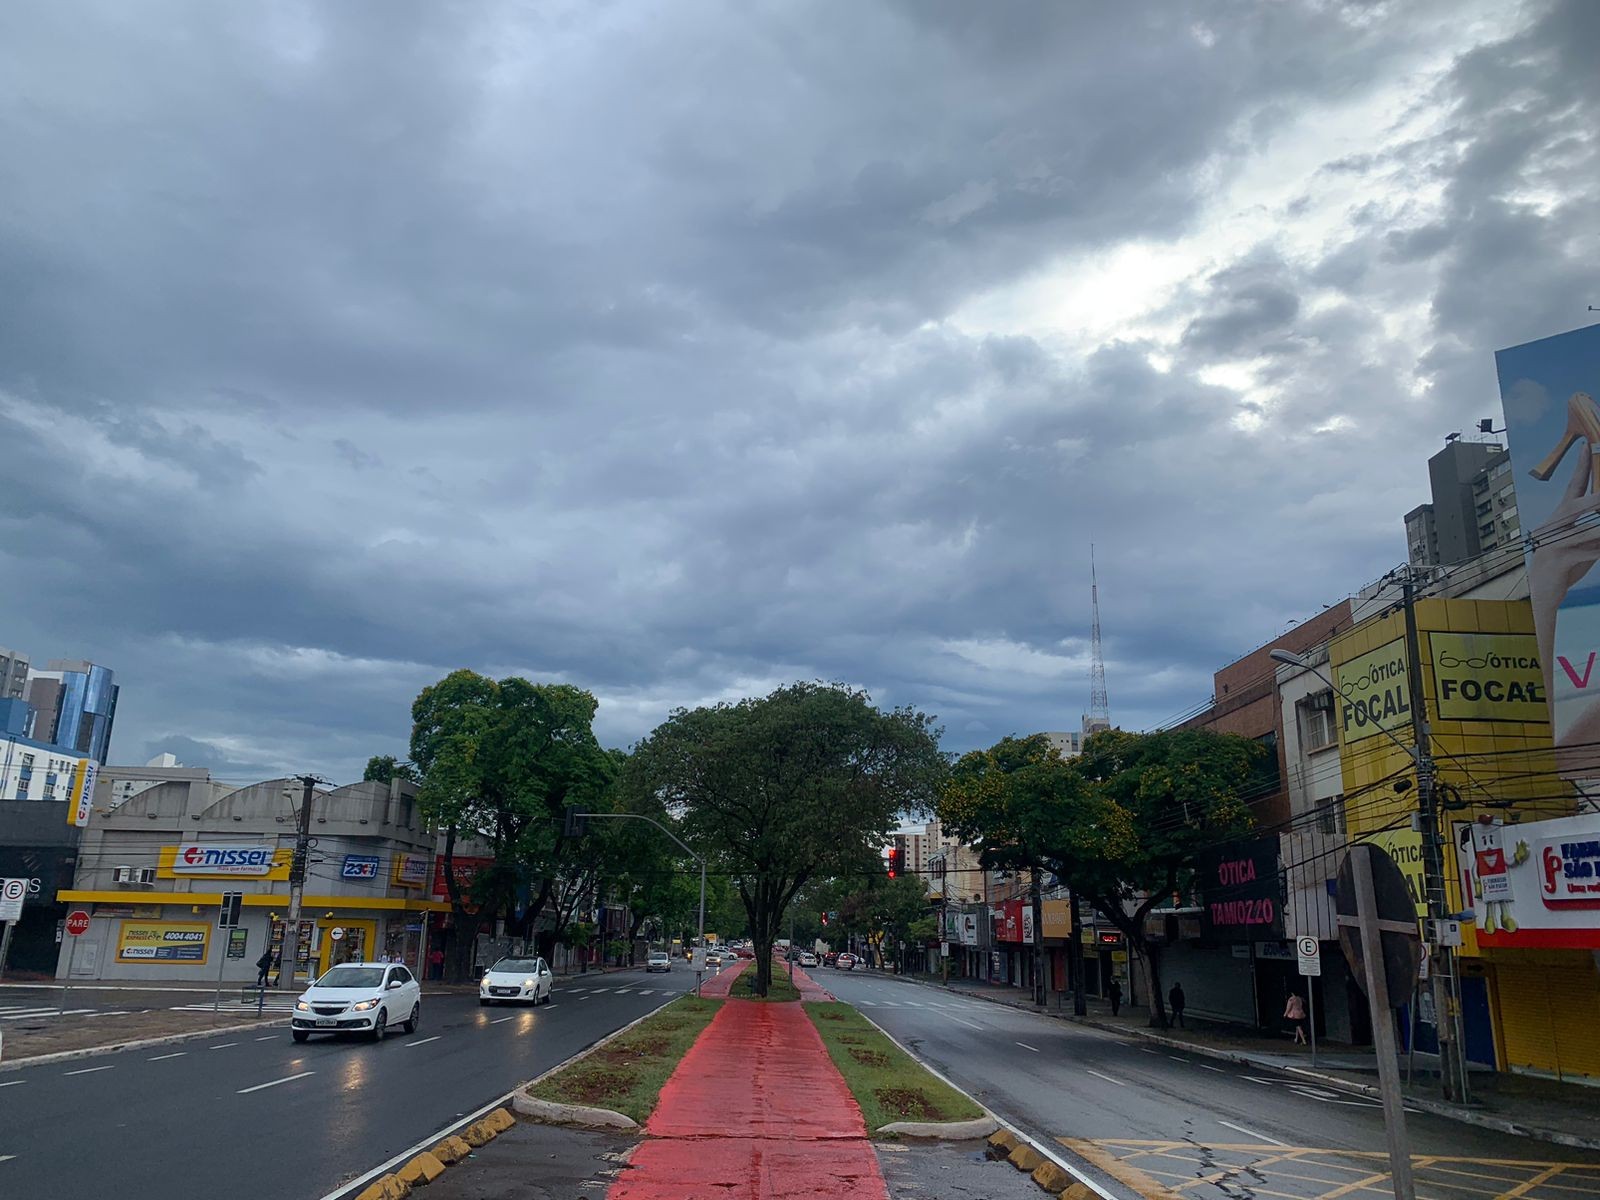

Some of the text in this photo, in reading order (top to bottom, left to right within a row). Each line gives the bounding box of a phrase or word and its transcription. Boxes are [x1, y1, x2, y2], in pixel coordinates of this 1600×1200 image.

[1490, 653, 1541, 669] ÓTICA
[1371, 657, 1405, 685] ÓTICA
[1441, 679, 1547, 703] FOCAL
[1342, 685, 1410, 732] FOCAL
[205, 850, 268, 865] nissei
[9, 885, 19, 895] E
[1211, 897, 1273, 925] TAMIOZZO
[67, 919, 88, 928] PARE
[1305, 941, 1312, 953] E
